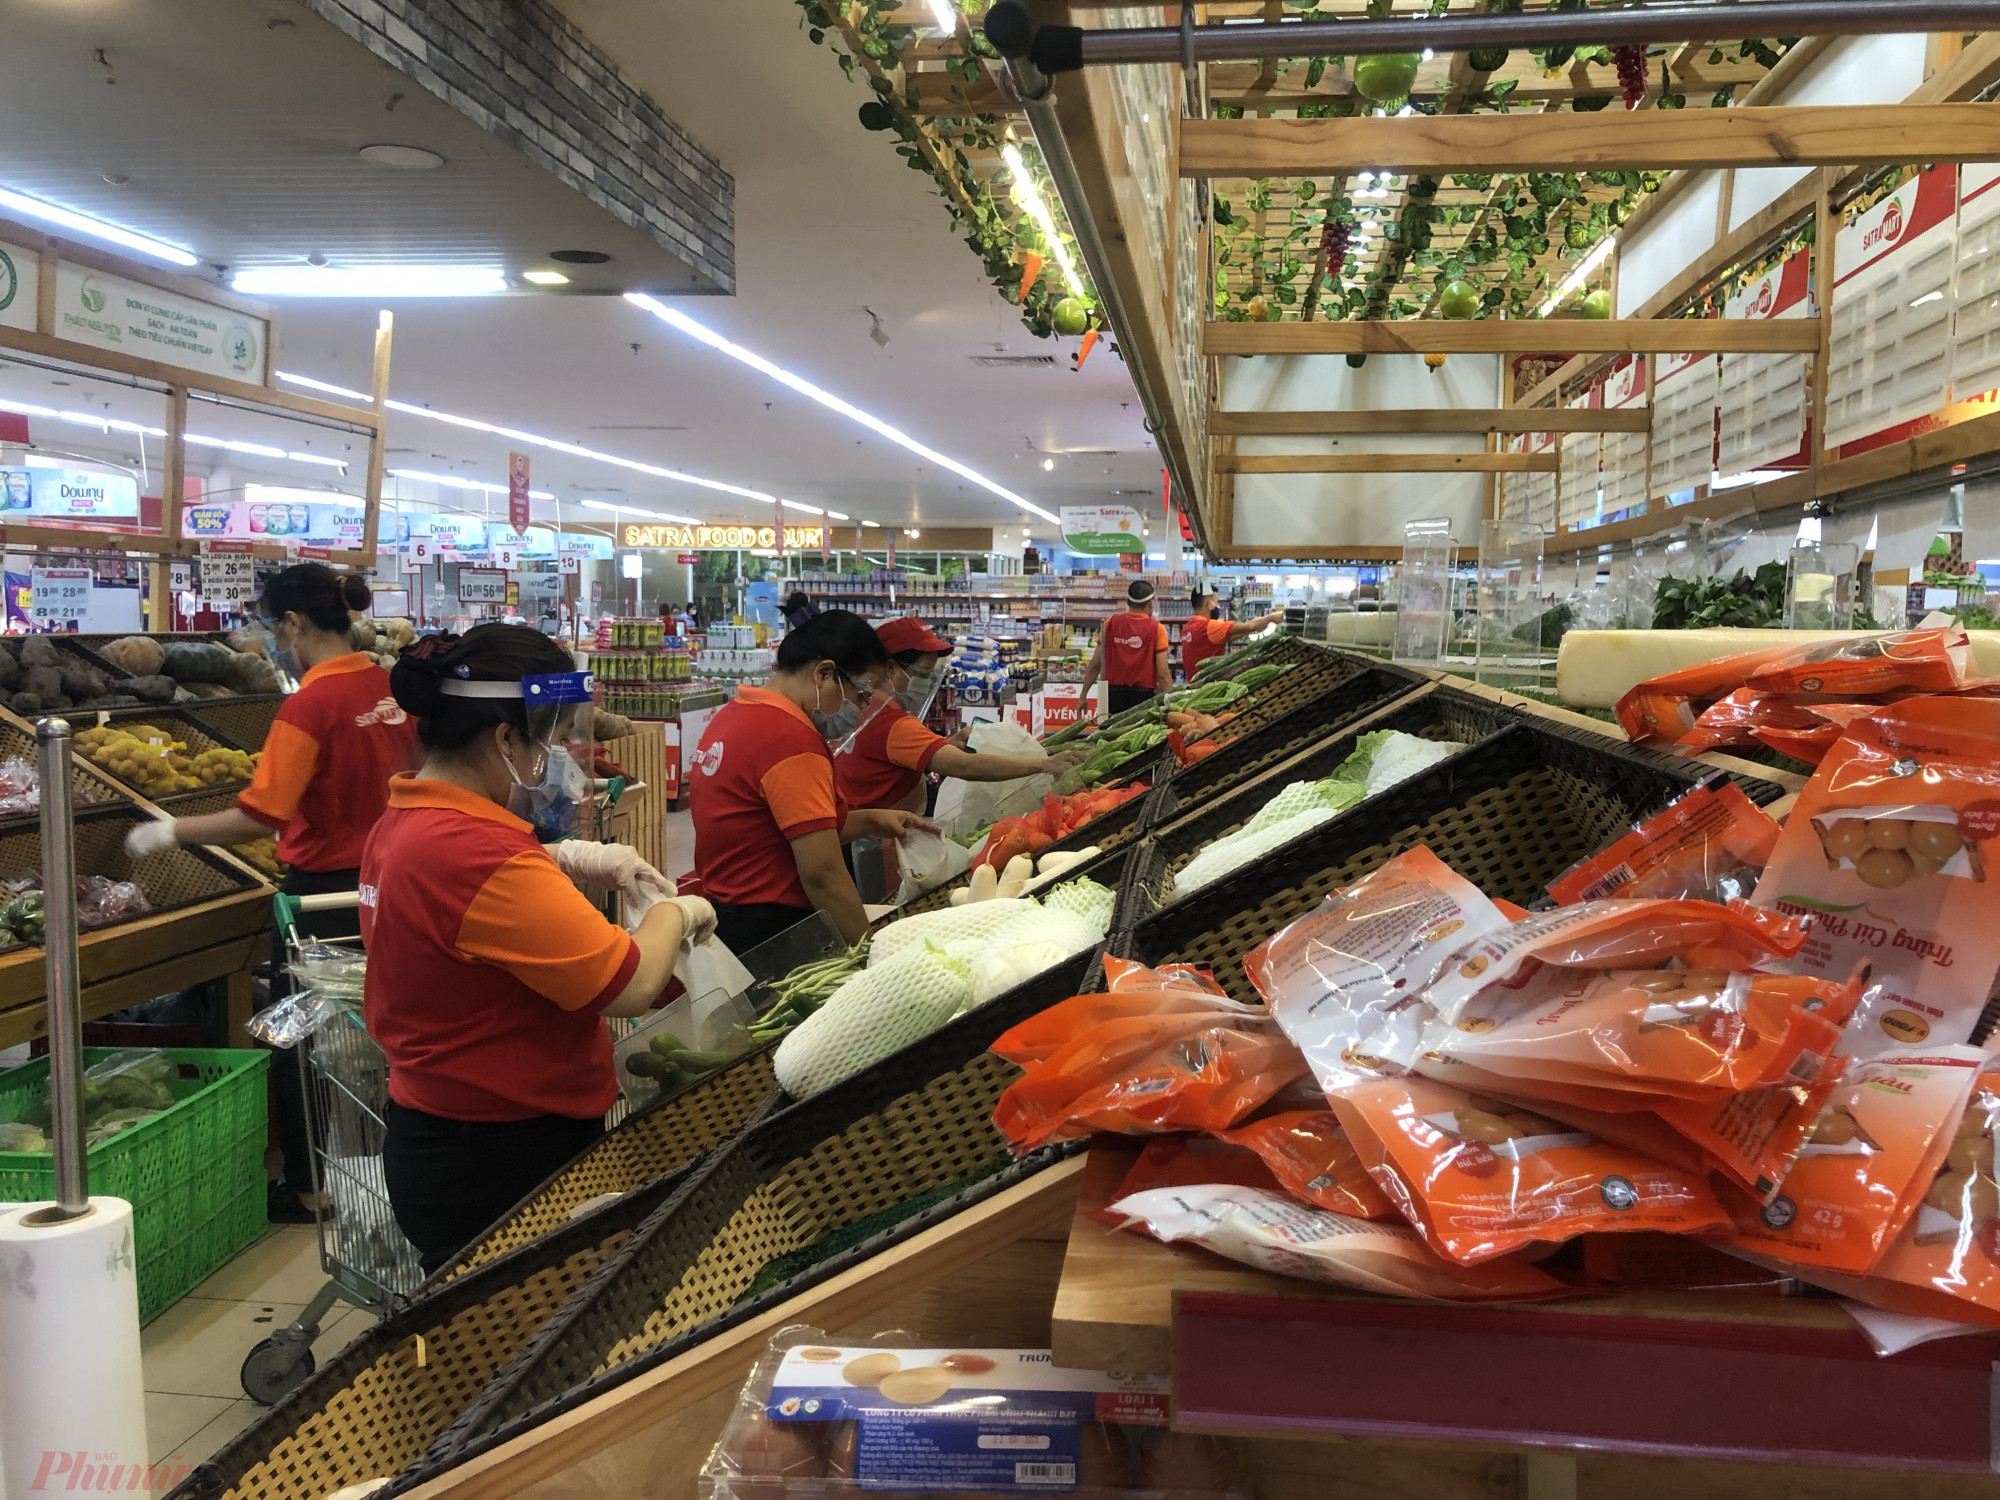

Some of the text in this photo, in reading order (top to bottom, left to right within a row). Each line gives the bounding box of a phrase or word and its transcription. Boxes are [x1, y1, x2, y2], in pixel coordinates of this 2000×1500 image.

[61, 484, 104, 502] Downy
[1100, 508, 1120, 516] Satra
[197, 518, 223, 529] 50%
[430, 523, 460, 535] Downy
[506, 533, 533, 544] Downy
[626, 525, 695, 548] SATRA
[697, 526, 757, 548] FOOD
[417, 544, 425, 557] 6
[568, 541, 595, 552] Downy
[503, 551, 510, 563] 8
[561, 557, 574, 568] 10
[225, 563, 237, 575] 26
[175, 572, 183, 585] 8
[36, 587, 49, 598] 19
[62, 587, 76, 598] 28
[204, 588, 212, 600] 22
[225, 587, 238, 600] 30
[461, 584, 473, 598] 10
[483, 584, 495, 598] 56
[62, 607, 75, 617] 21
[1851, 922, 1888, 948] Cút
[1892, 927, 1955, 968] Trứng
[1813, 1209, 1830, 1224] 42
